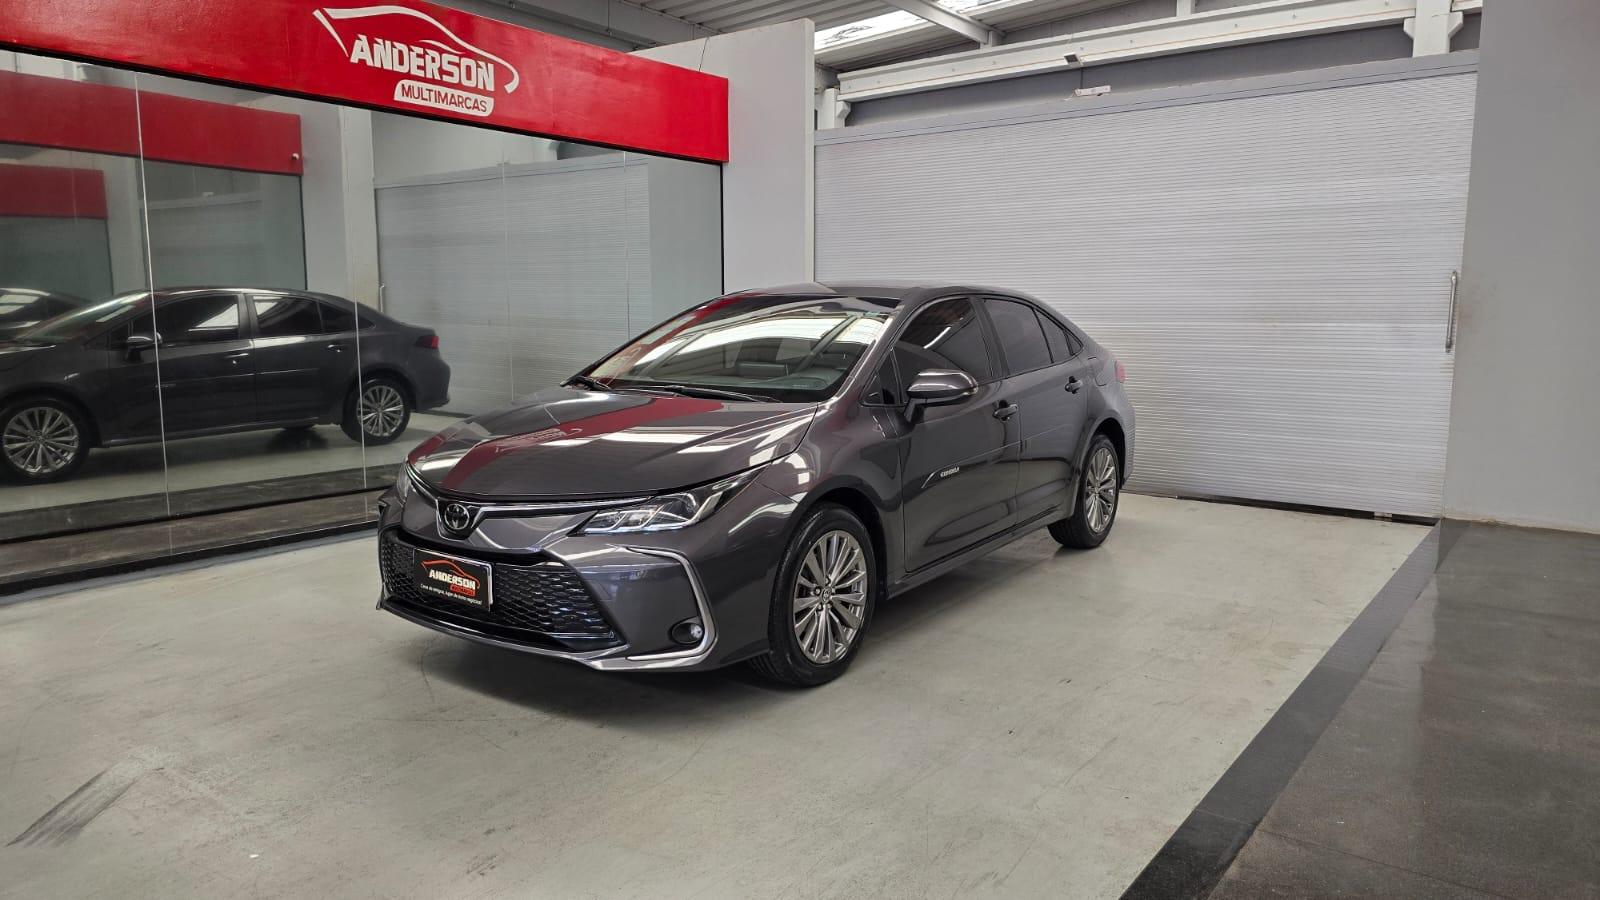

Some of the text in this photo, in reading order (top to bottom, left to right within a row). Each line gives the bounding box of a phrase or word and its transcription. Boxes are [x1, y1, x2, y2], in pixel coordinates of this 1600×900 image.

[350, 34, 495, 92] ANDERSON
[401, 83, 488, 112] MULTIMARCAS
[429, 569, 476, 590] ANDERSON
